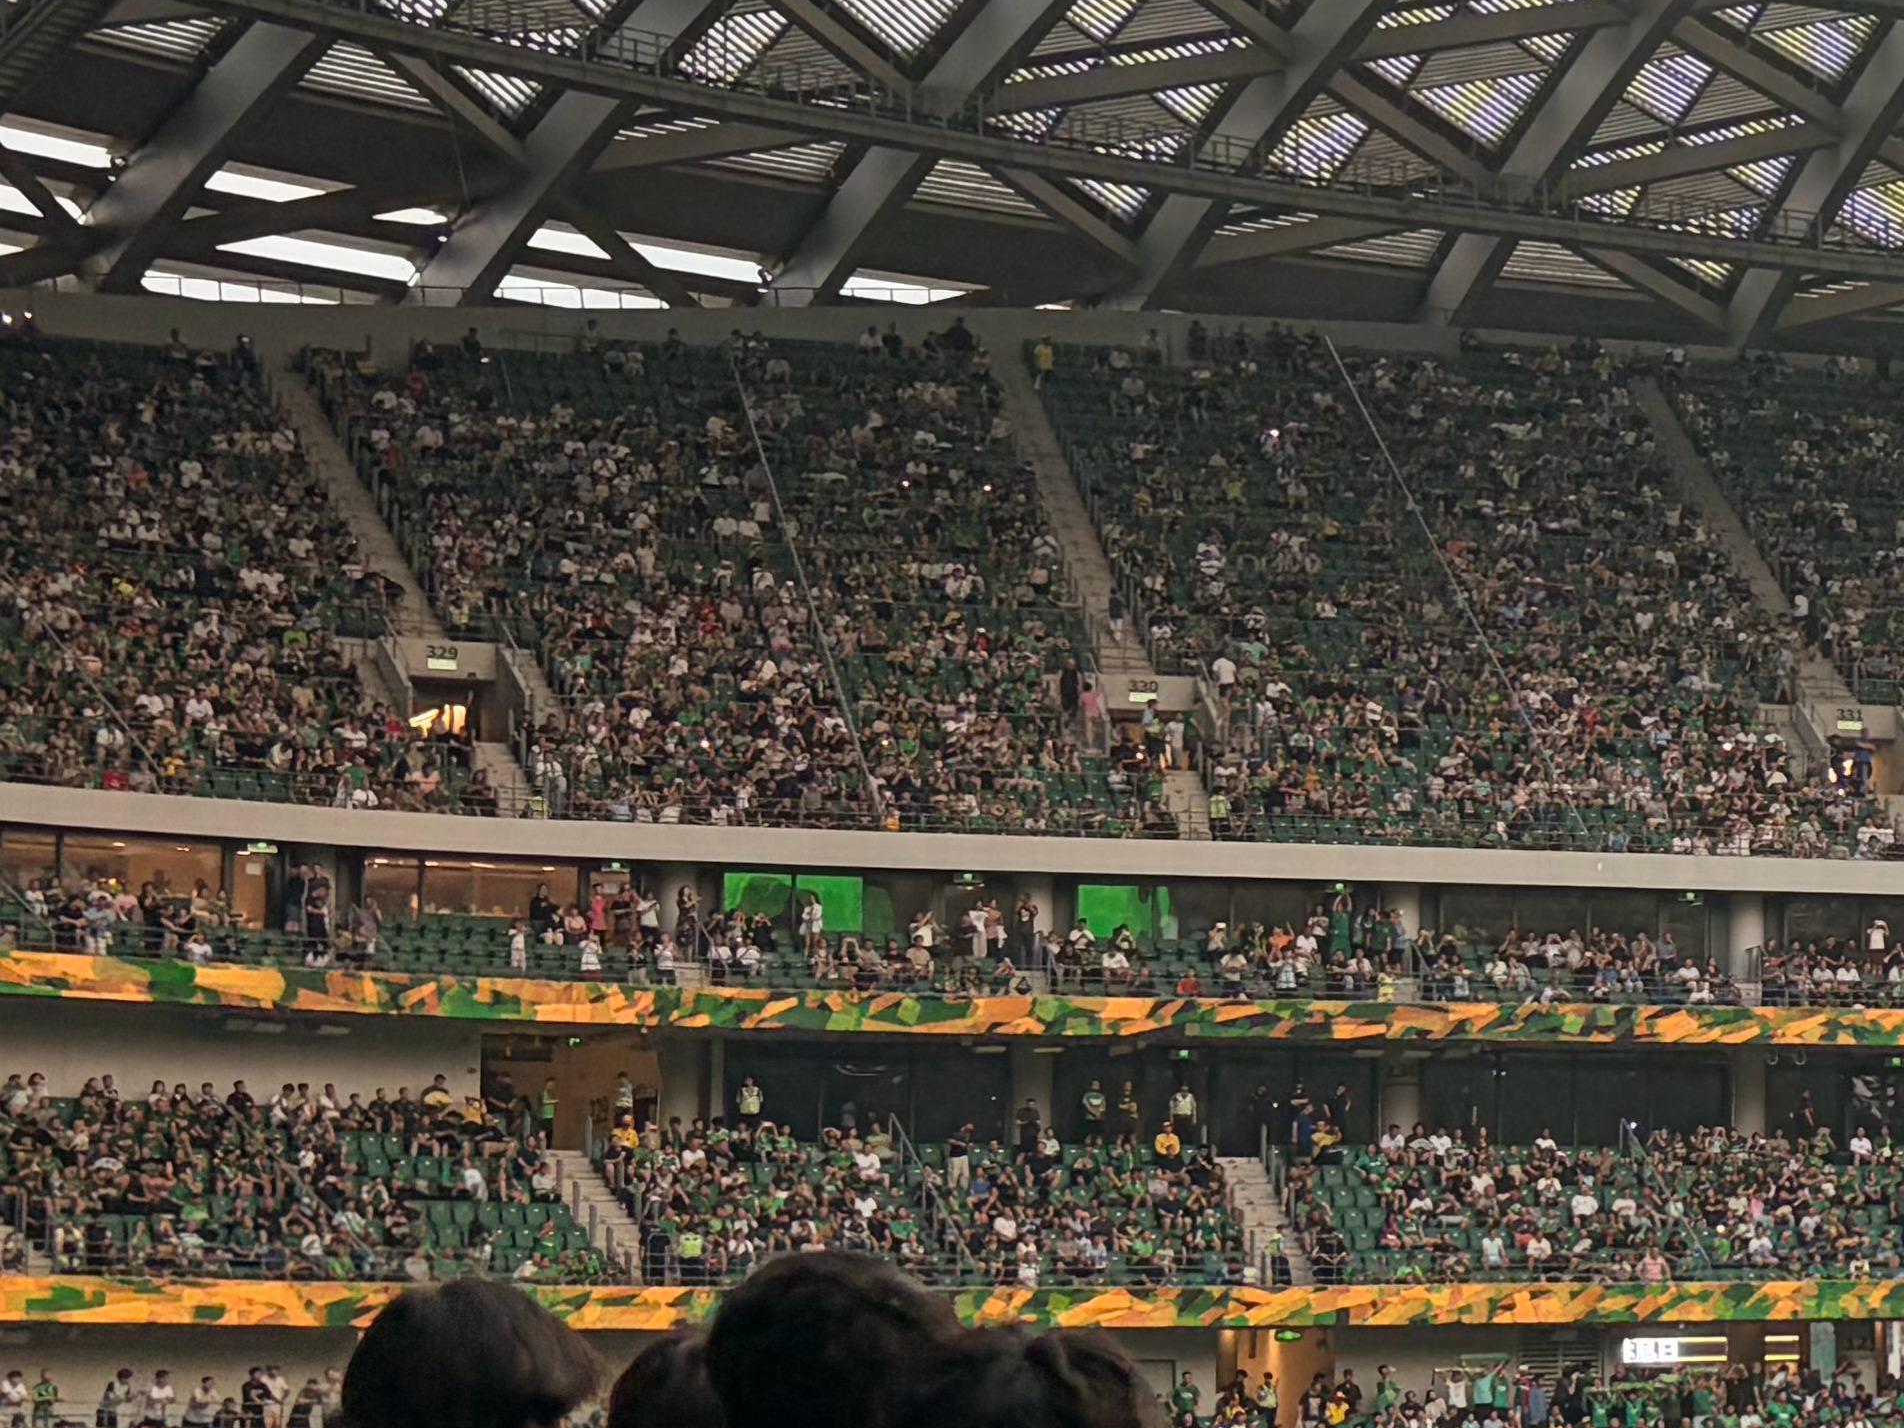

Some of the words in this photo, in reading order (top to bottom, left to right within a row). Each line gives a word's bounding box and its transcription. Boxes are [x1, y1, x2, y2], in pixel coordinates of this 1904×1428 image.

[426, 645, 458, 660] 329
[1128, 680, 1158, 693] 330
[1836, 708, 1862, 722] 331
